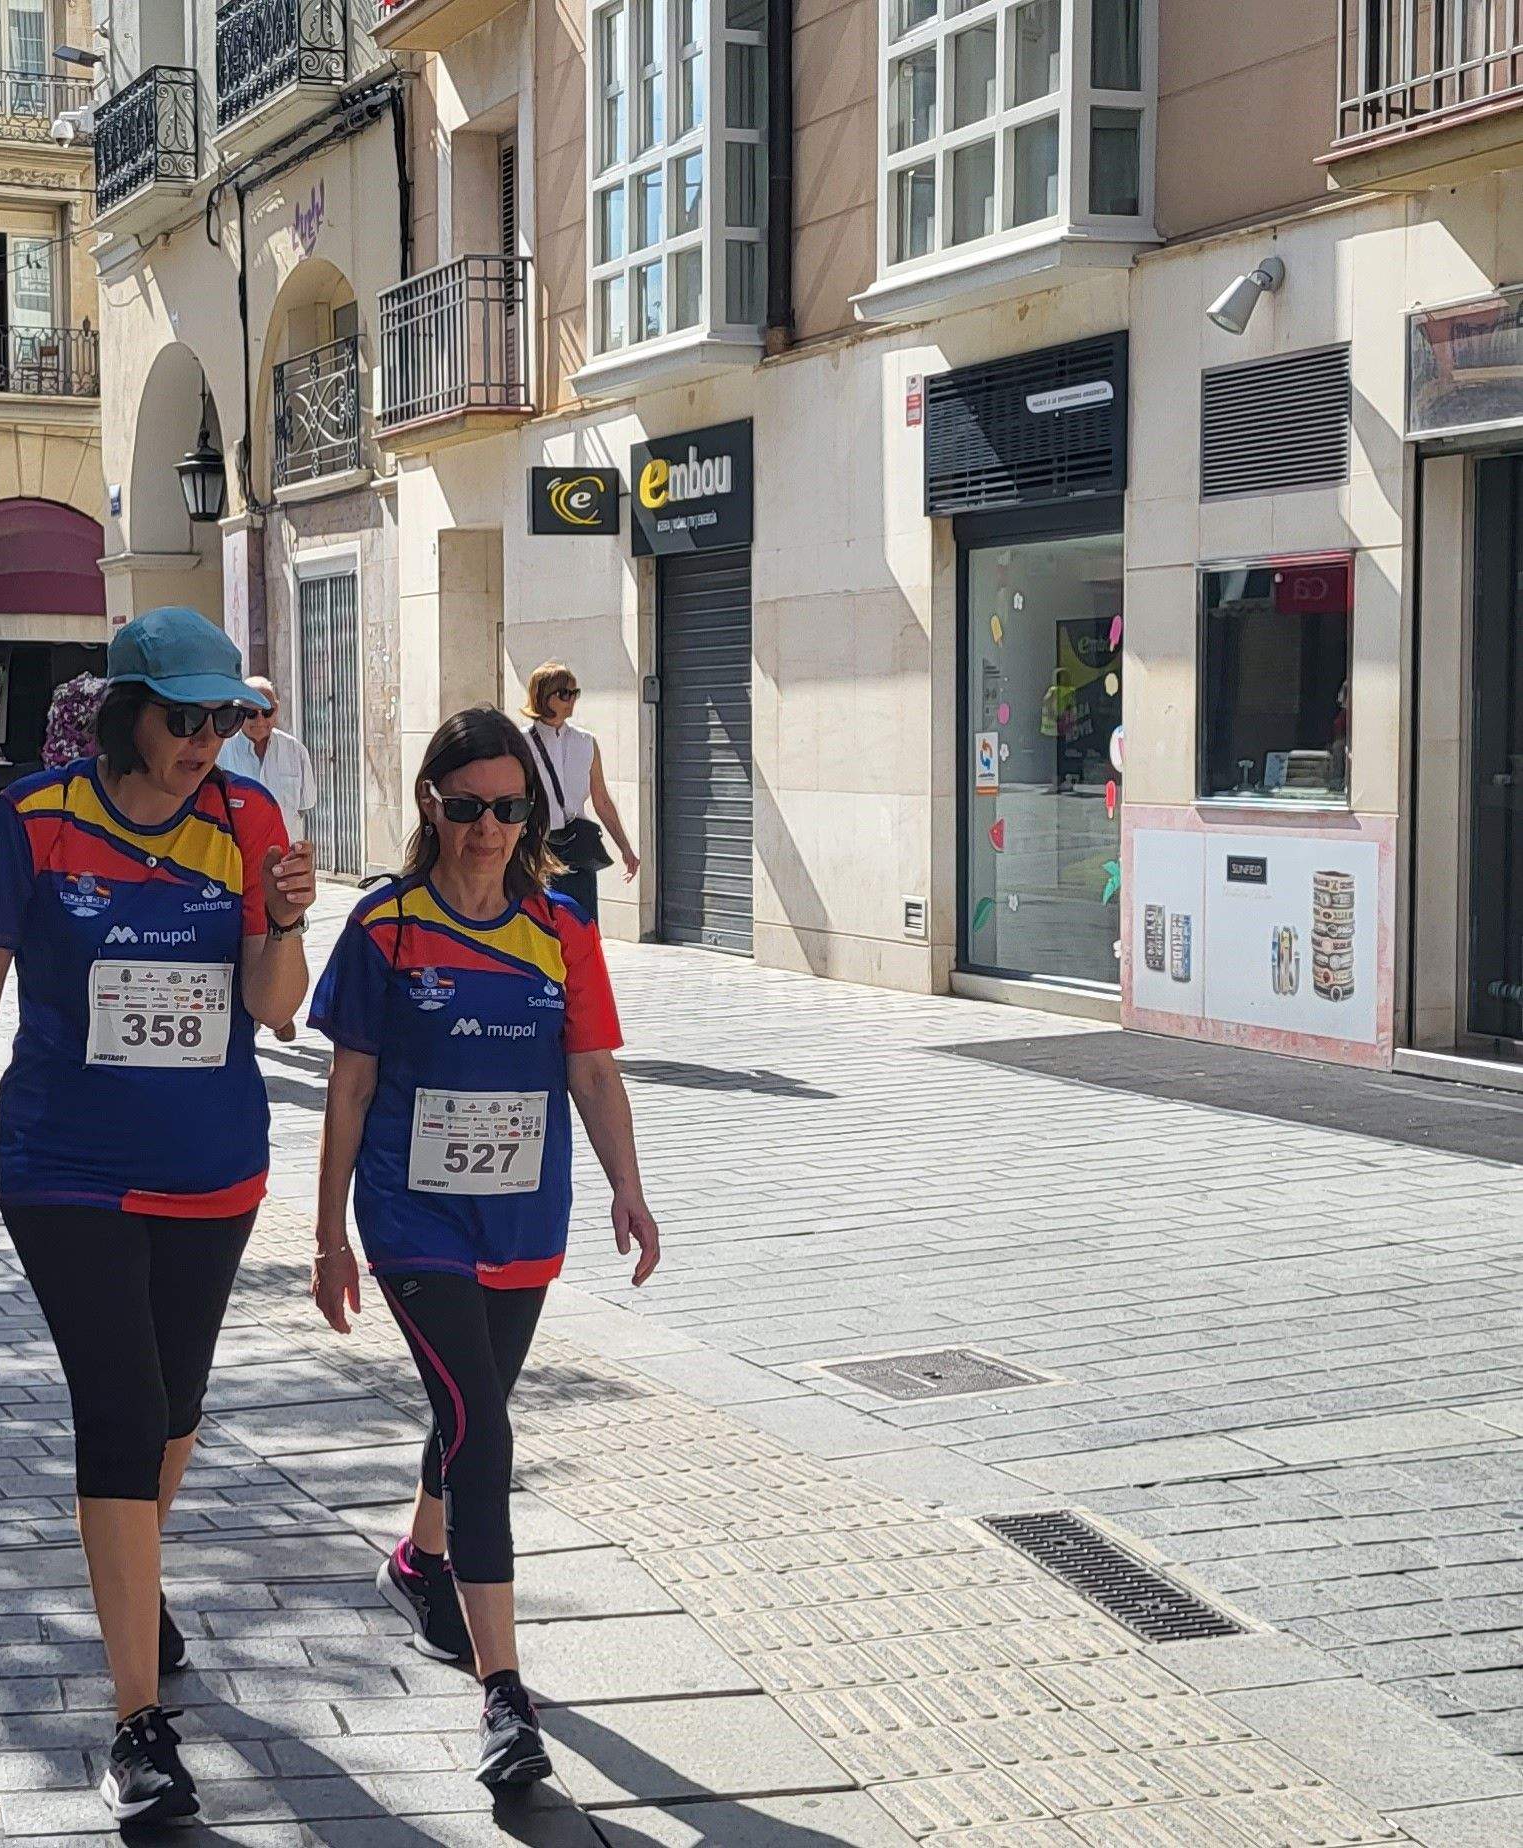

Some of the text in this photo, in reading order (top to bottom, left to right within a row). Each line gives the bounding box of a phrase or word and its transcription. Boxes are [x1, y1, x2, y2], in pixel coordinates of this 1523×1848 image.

[639, 446, 731, 509] embou
[143, 927, 197, 947] mupol
[121, 1014, 202, 1048] 358
[487, 1022, 537, 1040] mupol
[443, 1143, 520, 1174] 527
